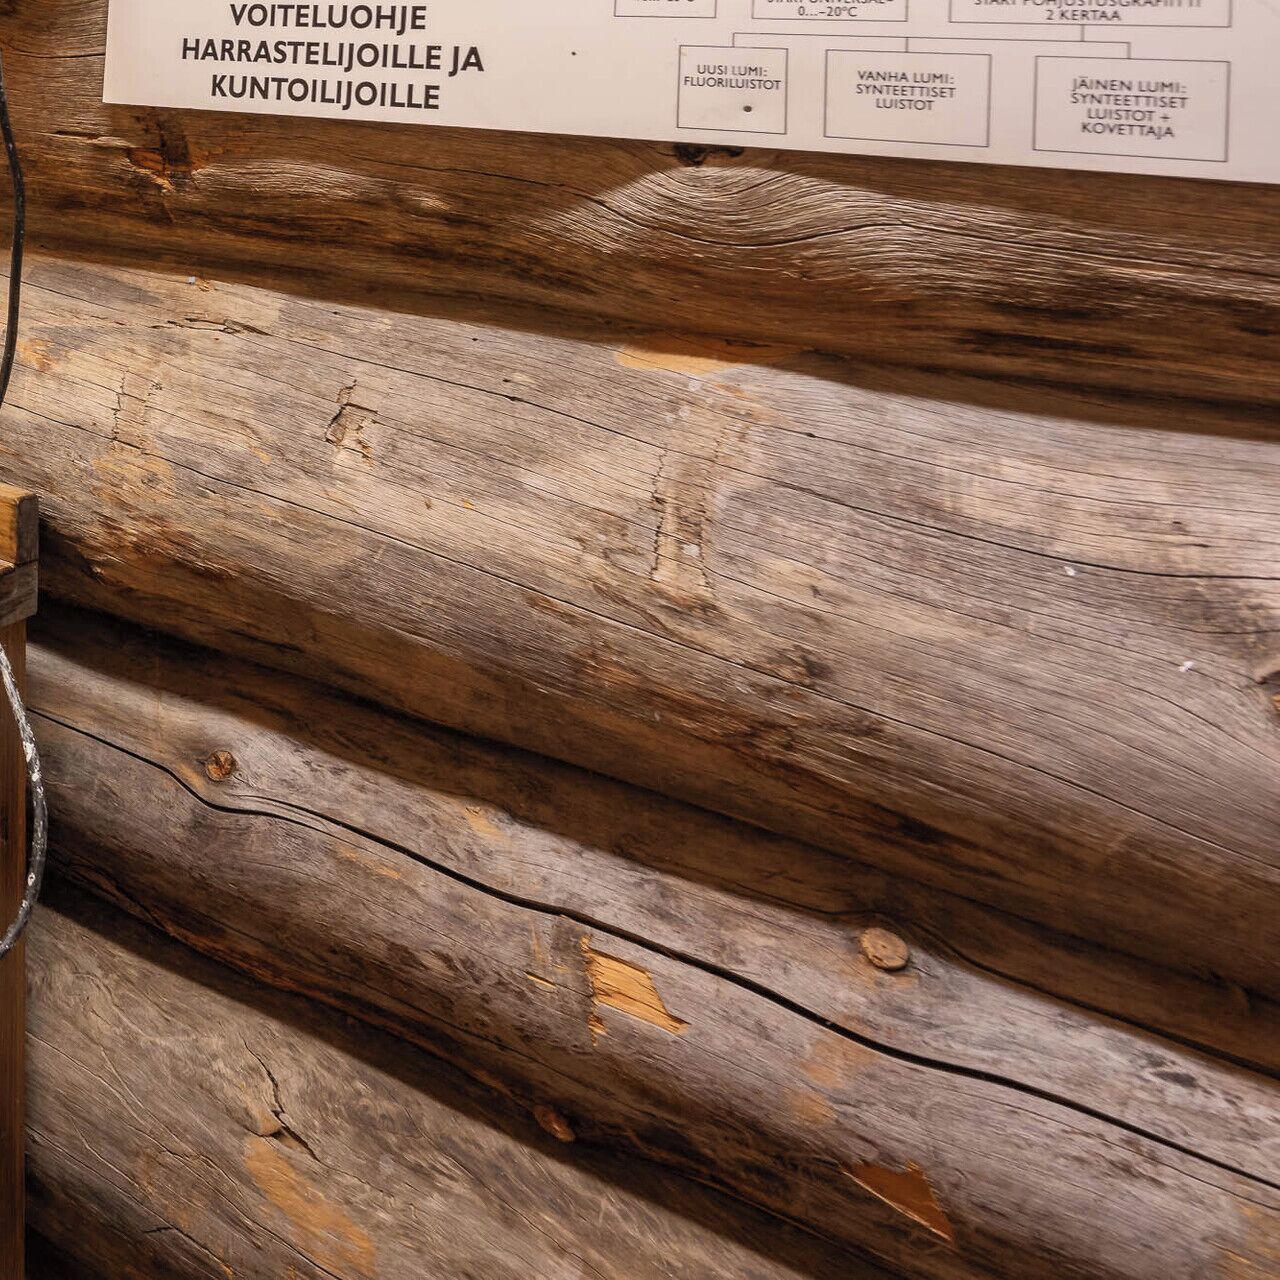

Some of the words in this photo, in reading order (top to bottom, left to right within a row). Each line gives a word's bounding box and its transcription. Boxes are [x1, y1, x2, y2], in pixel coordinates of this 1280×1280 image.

[230, 3, 427, 35] VOITELUOHJE
[1046, 10, 1055, 22] 2
[1059, 9, 1122, 22] KERTAA
[181, 38, 442, 73] HARRASTELIJOILLE
[448, 46, 484, 77] JA
[696, 64, 729, 77] UUSI
[732, 65, 768, 78] LUMI:
[857, 71, 909, 84] VANHA
[912, 72, 954, 85] LUMI:
[211, 74, 440, 110] KUNTOILIJOILLE
[683, 77, 781, 92] FLUORILUISTOT
[856, 85, 955, 98] SYNTEETTISET
[1072, 77, 1135, 94] JÄINEN
[1139, 79, 1187, 94] LUMI:
[875, 98, 934, 112] LUISTOT
[1070, 93, 1188, 109] SYNTEETTISET
[1087, 108, 1154, 122] LUISTOT
[1081, 121, 1175, 140] KOVETTAJA
